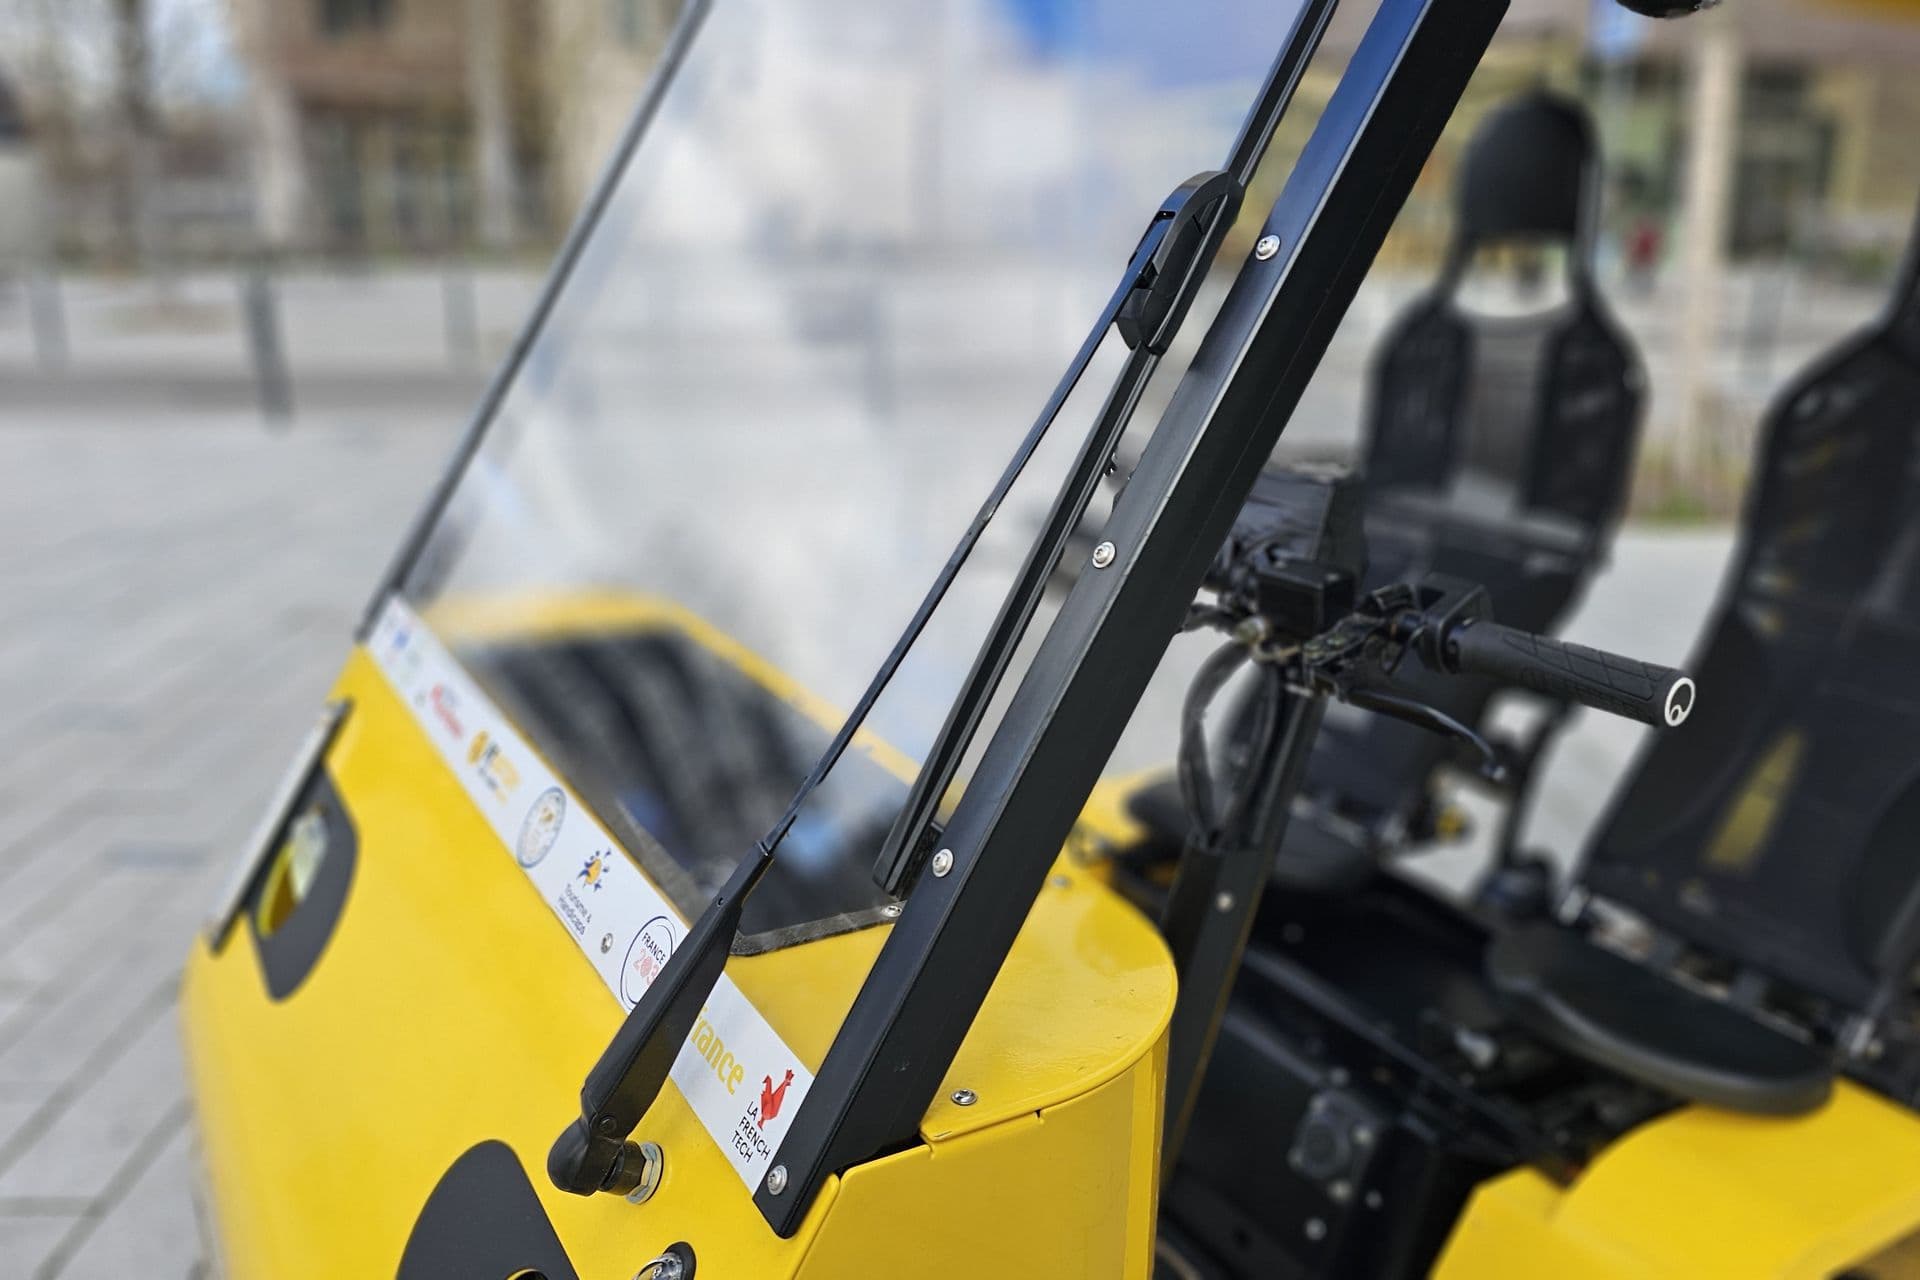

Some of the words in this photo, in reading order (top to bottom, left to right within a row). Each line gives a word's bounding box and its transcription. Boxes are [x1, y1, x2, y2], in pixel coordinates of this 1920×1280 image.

[642, 932, 666, 965] FRANCE
[633, 948, 660, 986] 203
[746, 1101, 758, 1121] LA
[731, 1130, 754, 1163] TECH
[739, 1116, 771, 1160] FRENCH
